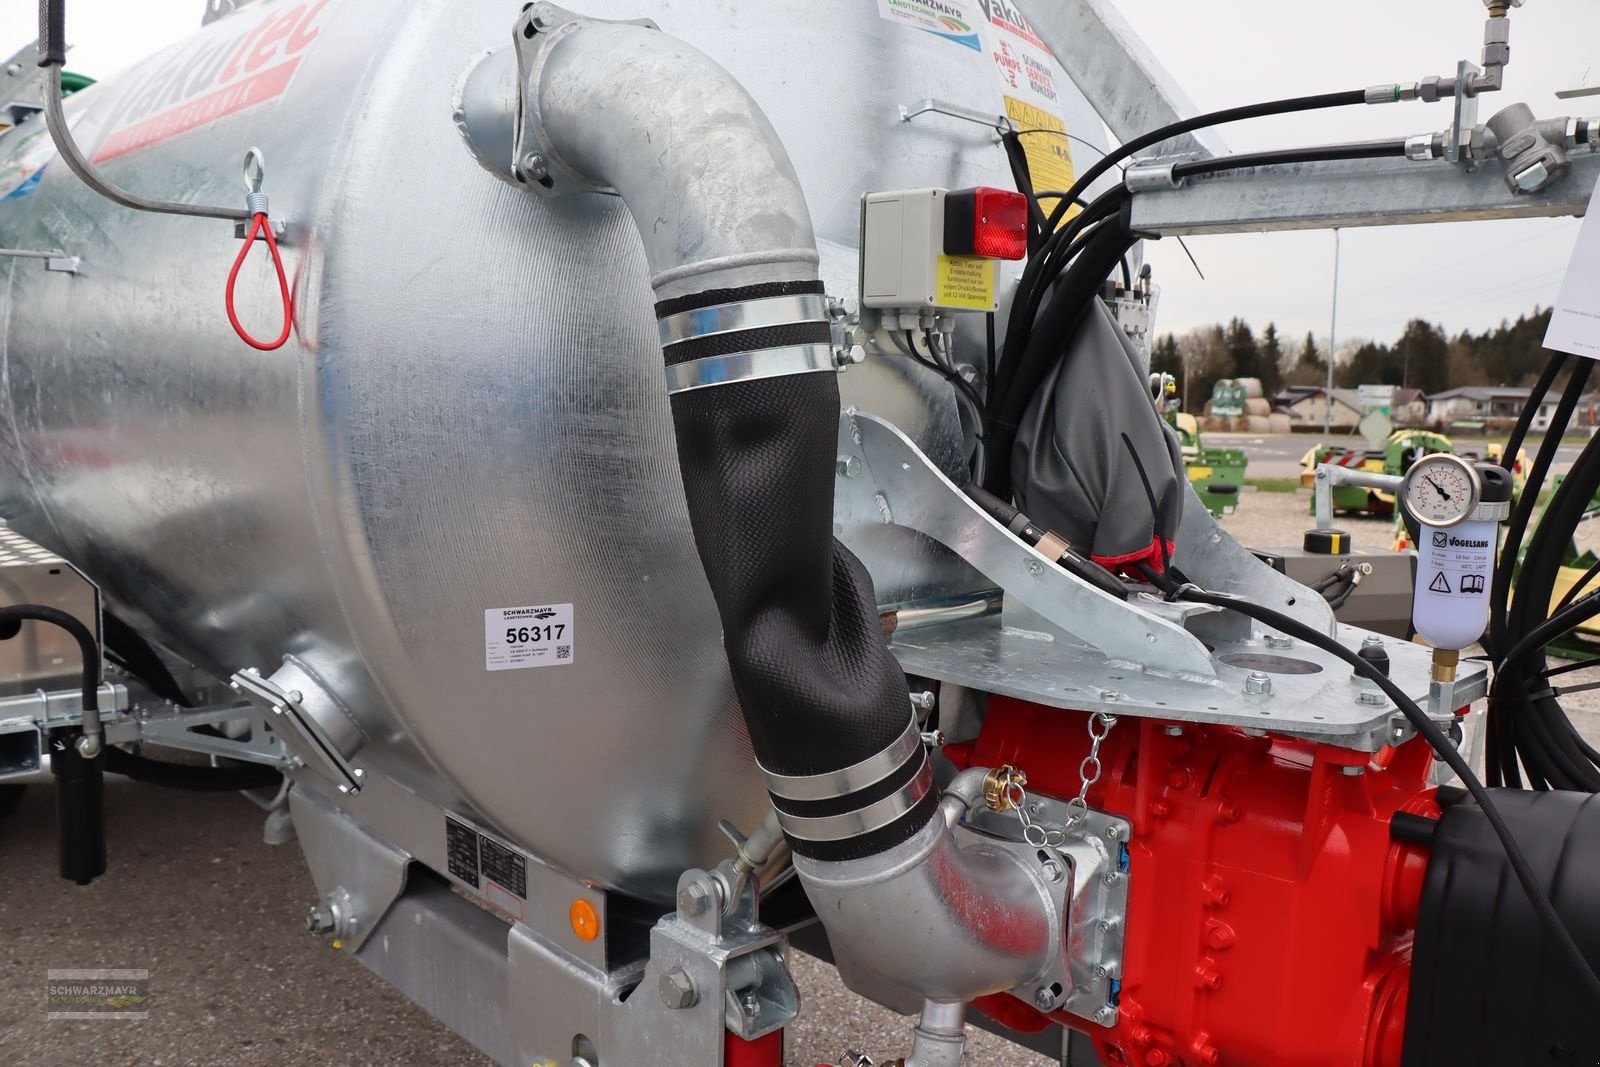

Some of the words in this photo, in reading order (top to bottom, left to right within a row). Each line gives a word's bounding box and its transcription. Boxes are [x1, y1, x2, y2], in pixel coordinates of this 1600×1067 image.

[1449, 536, 1488, 548] VOGELSANG
[503, 607, 552, 616] SCHWARZMAYR
[506, 624, 565, 643] 56317
